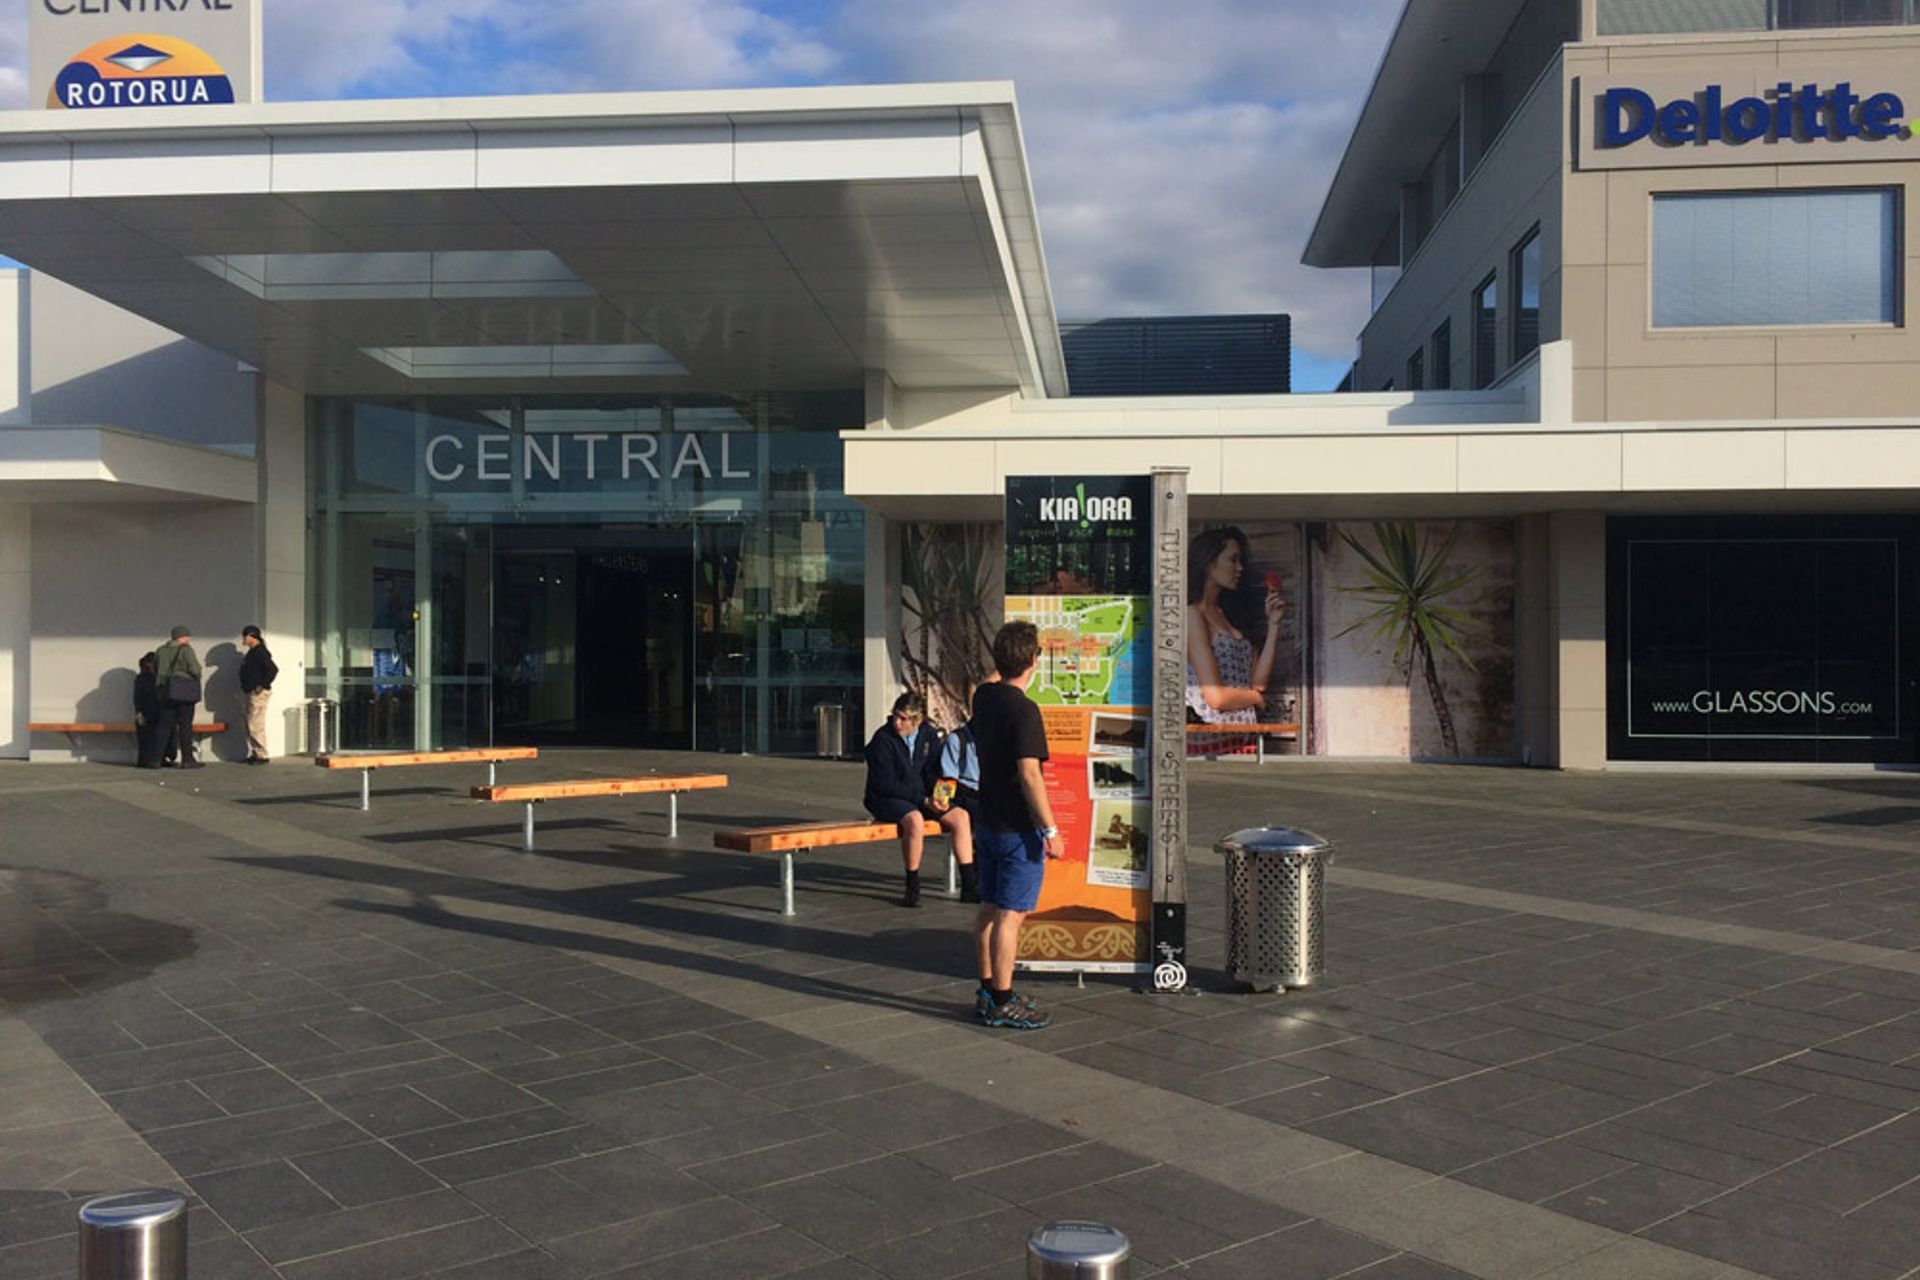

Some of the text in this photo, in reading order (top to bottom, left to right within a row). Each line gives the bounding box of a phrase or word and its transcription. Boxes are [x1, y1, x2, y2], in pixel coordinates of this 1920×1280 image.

[67, 79, 210, 106] ROTORUA
[425, 432, 751, 481] CENTRAL
[1159, 757, 1181, 844] STREETS
